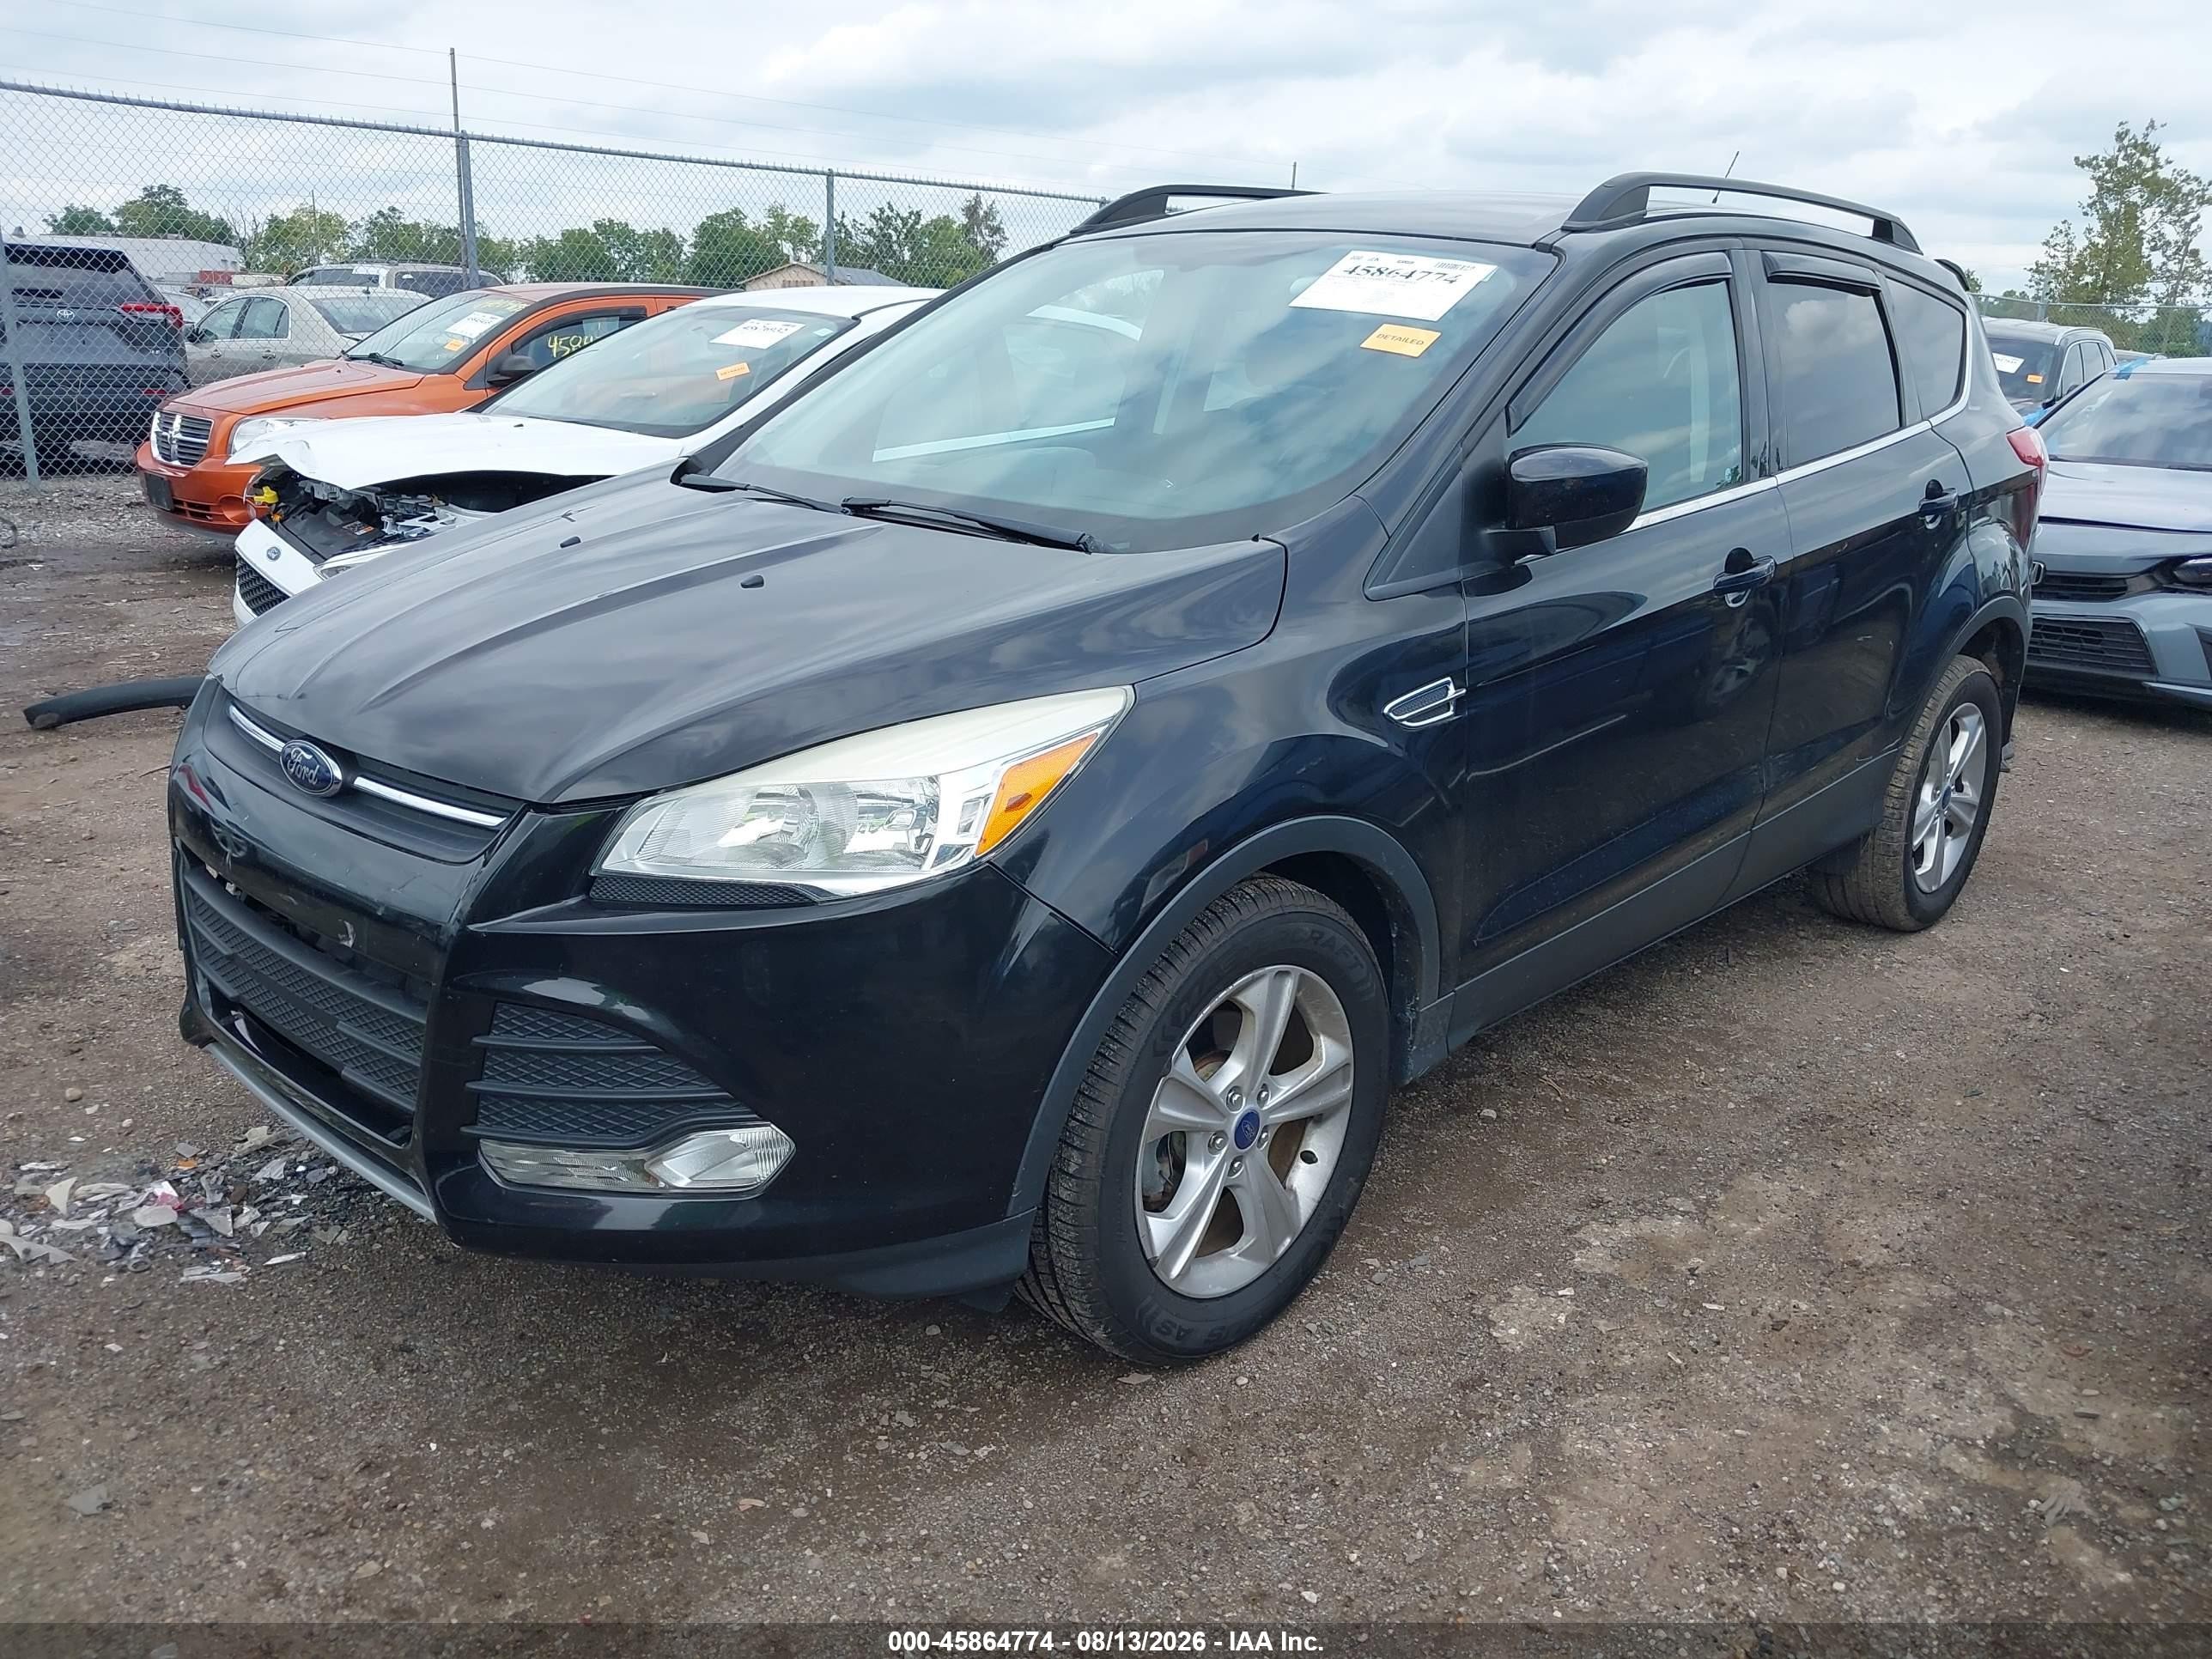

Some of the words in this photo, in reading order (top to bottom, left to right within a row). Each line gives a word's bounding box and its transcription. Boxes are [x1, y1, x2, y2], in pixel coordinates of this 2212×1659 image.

[1343, 265, 1462, 284] 45864774
[1376, 332, 1425, 345] DETAILED
[288, 747, 319, 785] Ford
